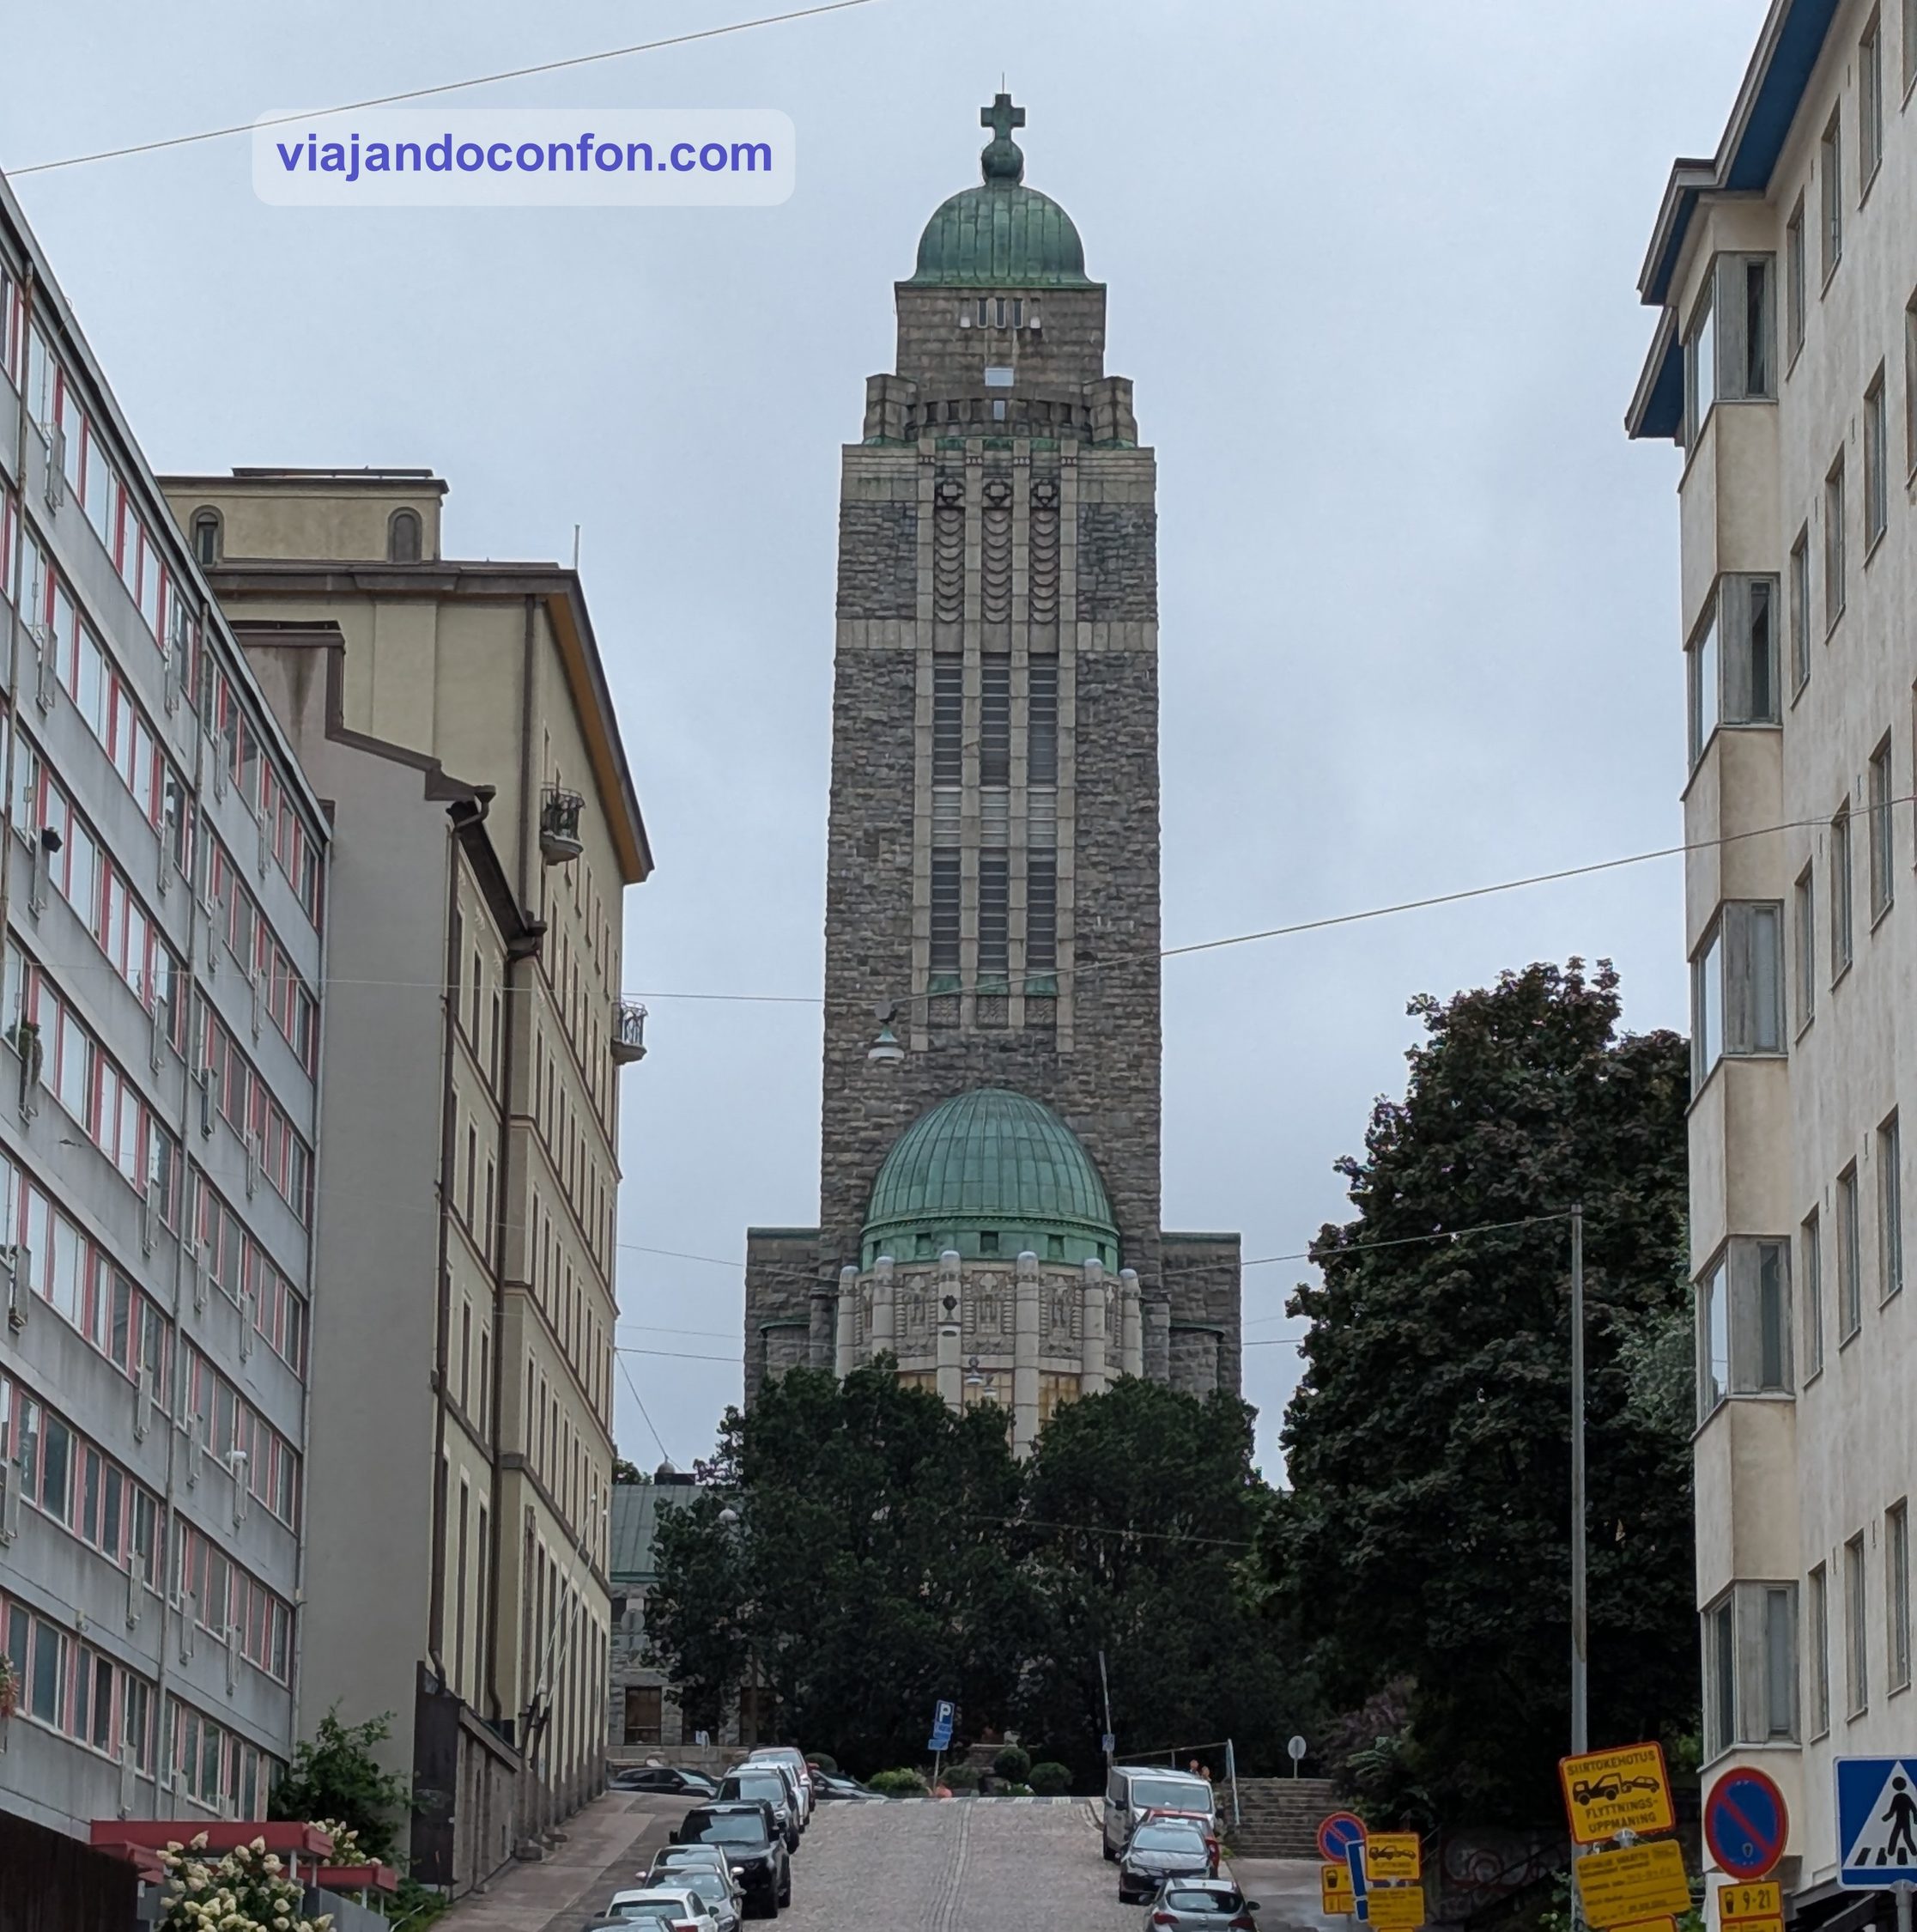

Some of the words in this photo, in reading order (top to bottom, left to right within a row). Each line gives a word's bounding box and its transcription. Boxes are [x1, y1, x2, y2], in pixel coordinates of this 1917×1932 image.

[939, 1703, 951, 1722] P
[1567, 1750, 1656, 1776] SIIRTOKEHOTUS
[1586, 1797, 1659, 1819] FLYTTNINGS-
[1589, 1812, 1657, 1833] UPPMANING
